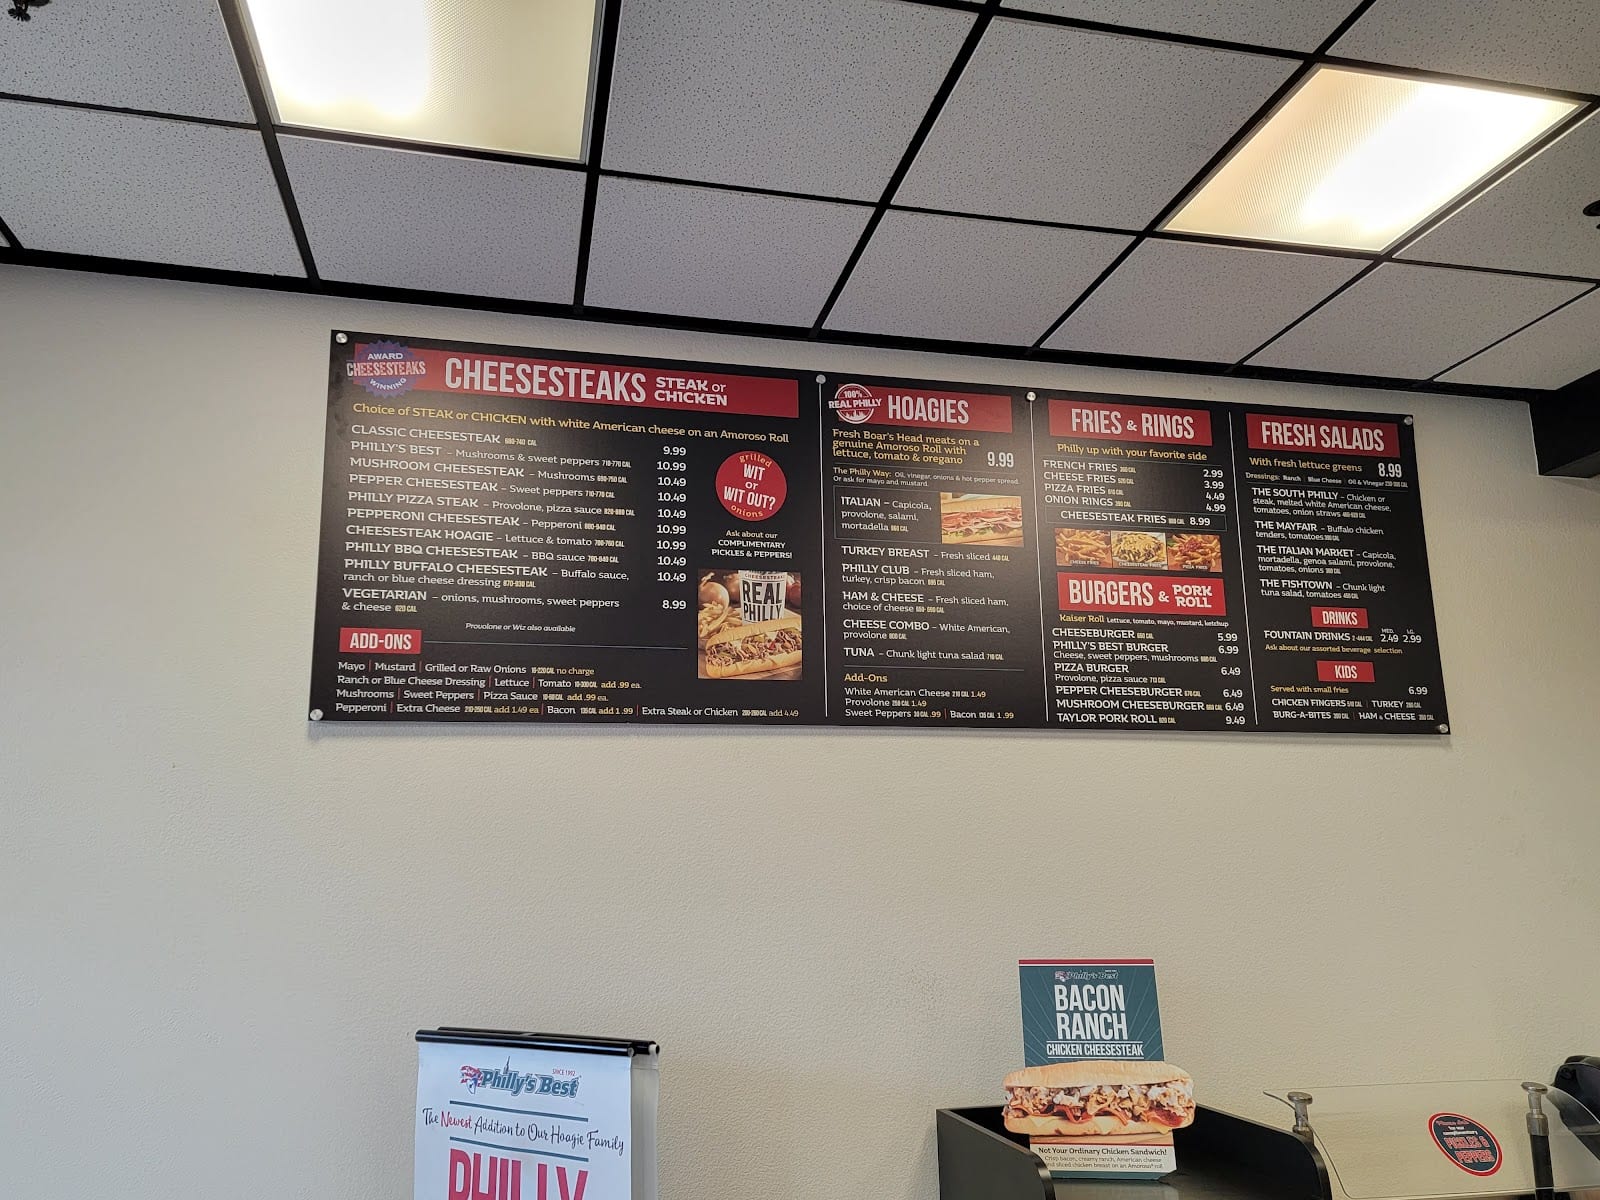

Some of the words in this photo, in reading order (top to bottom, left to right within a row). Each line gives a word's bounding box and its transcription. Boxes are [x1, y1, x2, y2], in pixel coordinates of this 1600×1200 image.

[346, 361, 426, 377] CHEESESTEAKS
[370, 378, 407, 390] WINNING
[444, 357, 647, 403] CHEESESTEAKS
[655, 376, 708, 392] STEAK
[712, 382, 726, 392] or
[654, 390, 728, 406] CHICKEN
[829, 400, 852, 409] REAL
[853, 399, 881, 407] PHILLY
[888, 395, 969, 424] HOAGIES
[353, 402, 395, 416] Choice
[397, 407, 410, 416] of
[412, 407, 454, 420] STEAK
[456, 411, 469, 420] or
[472, 412, 527, 424] CHICKEN
[530, 414, 555, 427] with
[558, 416, 590, 429] white
[593, 421, 645, 434] American
[649, 424, 685, 436] cheese
[688, 428, 701, 437] on
[703, 429, 717, 438] an
[720, 429, 766, 442] Amoroso
[769, 431, 789, 443] Roll
[1071, 408, 1122, 434] FRIES
[1127, 420, 1137, 431] &
[1141, 413, 1194, 440] RINGS
[351, 424, 406, 437] CLASSIC
[409, 429, 500, 443] CHEESESTEAK
[832, 429, 861, 439] Fresh
[864, 431, 894, 441] Boar's
[897, 433, 923, 443] Head
[925, 436, 955, 445] meats
[1261, 421, 1316, 447] FRESH
[1320, 426, 1384, 451] SALADS
[350, 441, 406, 454] PHILLY'S
[409, 445, 442, 455] BEST
[455, 449, 515, 461] Mushrooms
[528, 454, 558, 463] sweet
[560, 457, 600, 467] peppers
[663, 446, 686, 456] 9.99
[833, 449, 871, 459] lettuce,
[874, 452, 910, 461] tomato
[913, 454, 920, 462] &
[923, 456, 962, 465] oregano
[1057, 443, 1085, 454] Philly
[1087, 447, 1099, 455] up
[1102, 447, 1124, 456] with
[1126, 450, 1146, 458] your
[1149, 450, 1185, 459] favorite
[1188, 452, 1207, 461] side
[657, 461, 686, 471] 10.99
[987, 452, 1014, 468] 9.99
[1043, 460, 1085, 470] FRENCH
[1088, 463, 1117, 472] FRIES
[1249, 458, 1272, 466] With
[1274, 459, 1297, 468] fresh
[1299, 461, 1330, 470] lettuce
[1332, 463, 1362, 472] greens
[350, 457, 430, 471] MUSHROOM
[434, 462, 524, 477] CHEESESTEAK
[744, 464, 765, 480] WIT
[1203, 469, 1223, 478] 2.99
[1378, 462, 1402, 478] 8.99
[658, 477, 686, 486] 10.49
[745, 482, 758, 490] or
[724, 486, 745, 503] WIT
[747, 492, 775, 510] OUT?
[1045, 495, 1079, 505] ONION
[1082, 497, 1113, 506] RINGS
[1252, 488, 1271, 496] THE
[1273, 489, 1305, 498] SOUTH
[1308, 491, 1339, 500] PHILLY
[841, 496, 880, 507] ITALIAN
[1206, 504, 1226, 512] 4.99
[731, 505, 763, 517] onions
[1060, 510, 1135, 523] CHEESESTEAK
[1138, 514, 1166, 524] FRIES
[1190, 518, 1210, 526] 8.99
[1254, 521, 1274, 529] THE
[1276, 522, 1317, 531] MAYFAIR
[346, 525, 442, 538] CHEESESTEAK
[445, 530, 493, 541] HOAGIE
[657, 540, 686, 550] 10.99
[718, 540, 785, 549] COMPLIMENTARY
[712, 549, 744, 557] PICKLES
[841, 546, 886, 556] TURKEY
[888, 548, 930, 558] BREAST
[742, 580, 782, 604] REAL
[1069, 579, 1153, 606] BURGERS
[1158, 591, 1169, 603] &
[1172, 584, 1213, 596] PORK
[1175, 596, 1212, 608] ROLL
[744, 603, 782, 621] PHILLY
[1322, 611, 1357, 625] DRINKS
[1052, 628, 1135, 638] CHEESEBURGER
[1218, 633, 1237, 641] 5.99
[1264, 630, 1312, 640] FOUNTAIN
[1314, 631, 1350, 641] DRINKS
[1380, 634, 1398, 642] 2.49
[1403, 635, 1422, 643] 2.99
[350, 633, 411, 649] ADD-ONS
[1053, 641, 1096, 650] PHILLY'S
[1099, 642, 1124, 651] BEST
[1127, 643, 1168, 652] BURGER
[843, 648, 874, 657] TUNA
[1218, 646, 1239, 654] 6.99
[338, 661, 366, 671] Mayo
[375, 662, 416, 671] Mustard
[1335, 665, 1357, 678] KIDS
[844, 673, 887, 683] Add-Ons
[1408, 687, 1428, 695] 6.99
[1272, 698, 1309, 707] CHICKEN
[1311, 699, 1346, 707] FINGERS
[1372, 700, 1403, 708] TURKEY
[1057, 713, 1096, 723] TAYLOR
[1099, 714, 1129, 723] PORK
[1131, 714, 1157, 724] ROLL
[1226, 716, 1245, 725] 9.49
[1054, 984, 1125, 1011] BACON
[1056, 1013, 1128, 1040] RANCH
[1047, 1043, 1082, 1056] CHICKEN
[1085, 1043, 1143, 1056] CHEESESTEAK
[482, 1069, 536, 1096] Philly's
[538, 1076, 579, 1098] Best
[423, 1108, 438, 1125] The
[441, 1111, 472, 1129] Newest
[474, 1116, 513, 1136] Addition
[516, 1125, 525, 1136] to
[528, 1124, 547, 1141] Our
[551, 1126, 584, 1148] Hoagie
[587, 1131, 624, 1156] Family
[1069, 1148, 1100, 1156] Ordinary
